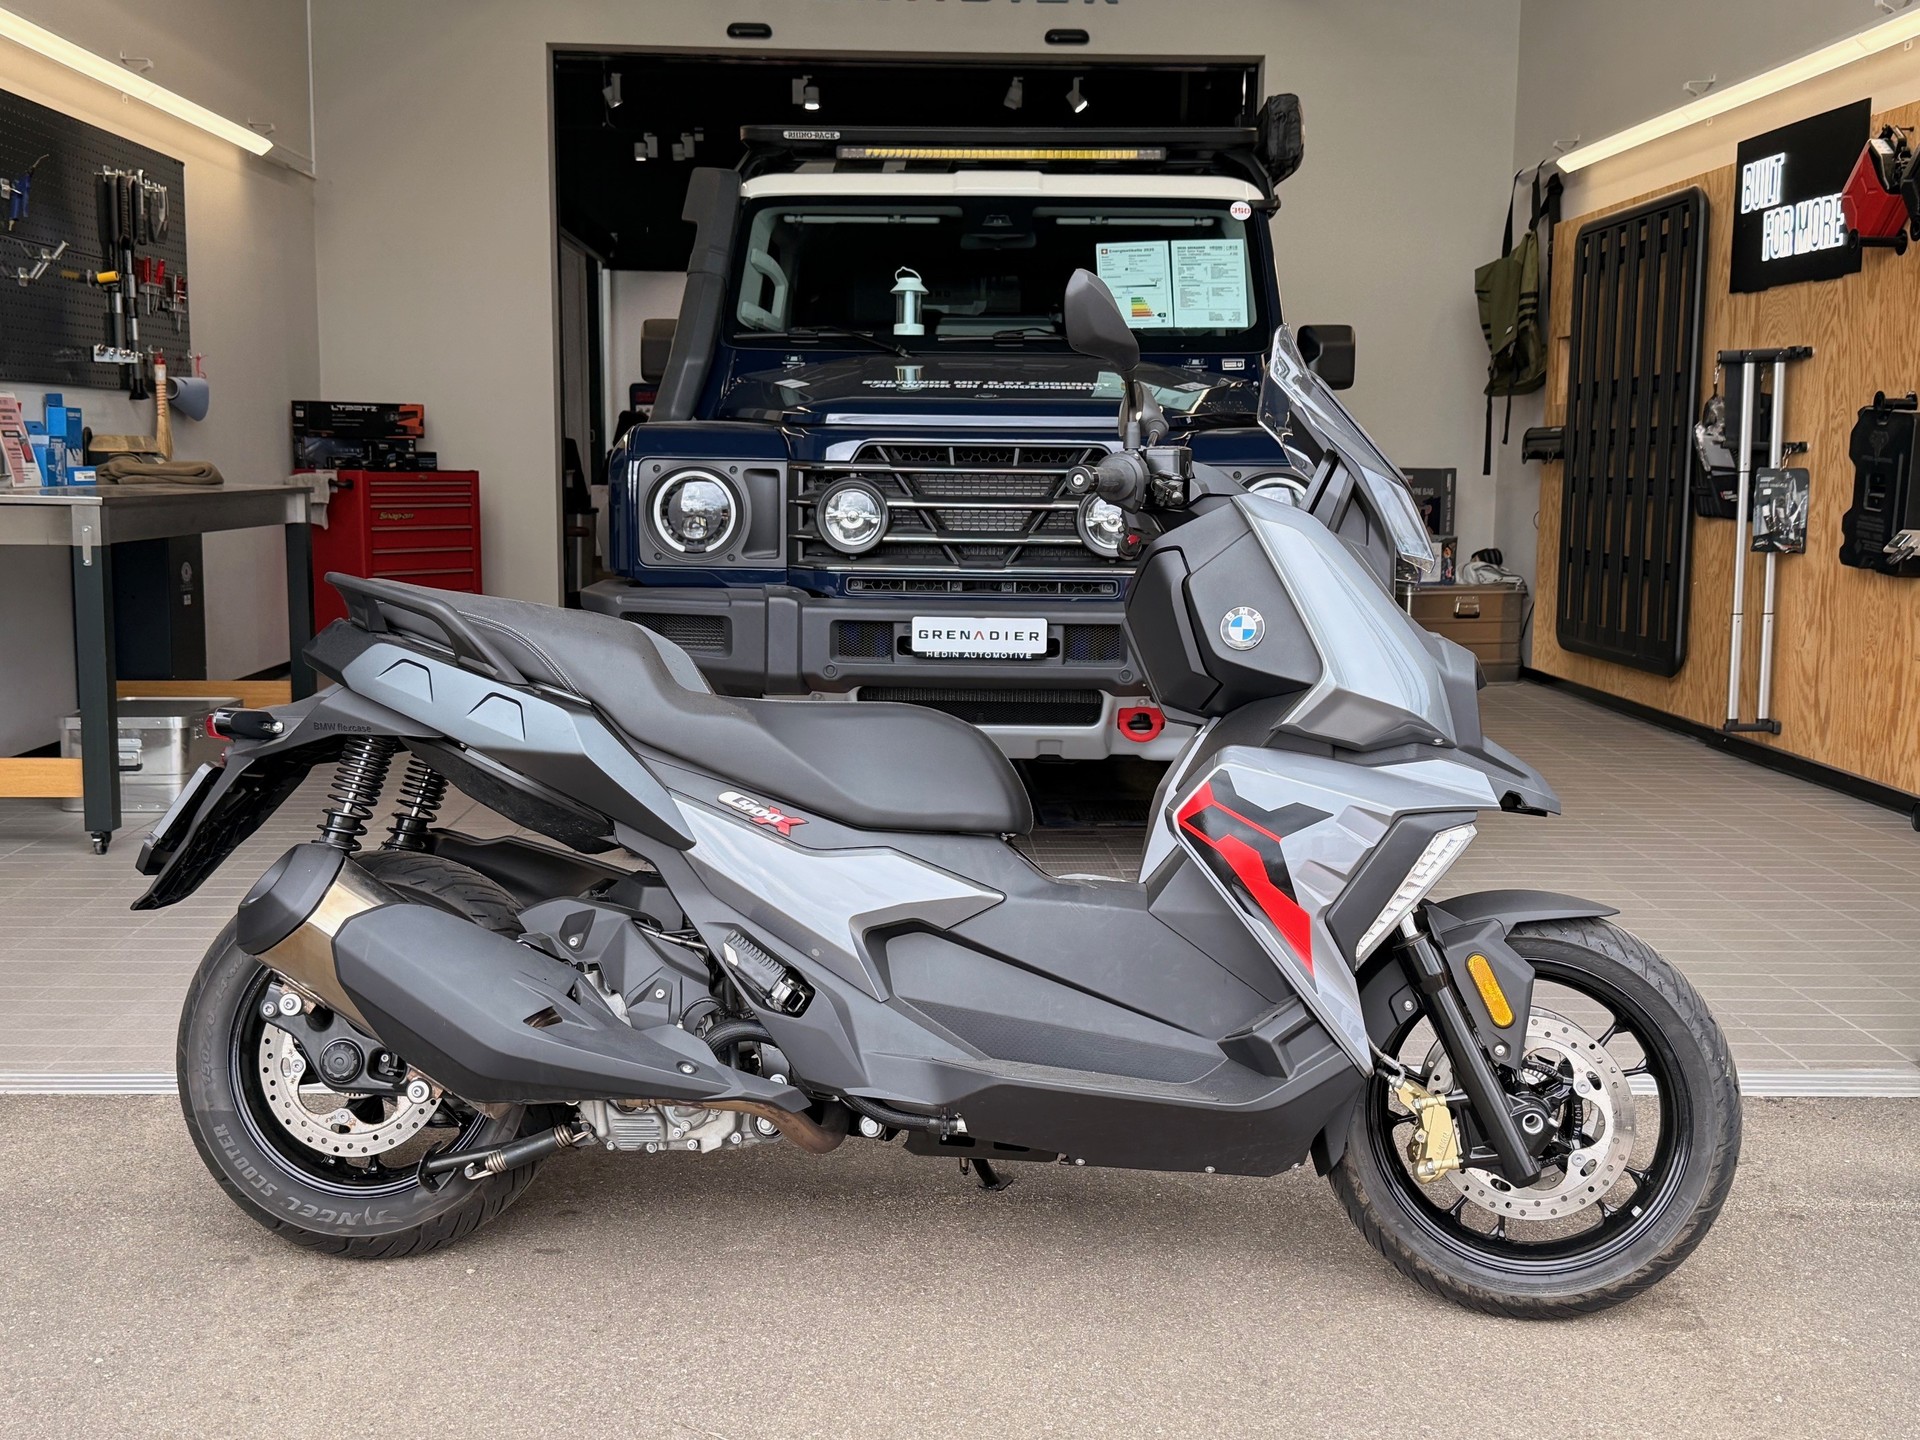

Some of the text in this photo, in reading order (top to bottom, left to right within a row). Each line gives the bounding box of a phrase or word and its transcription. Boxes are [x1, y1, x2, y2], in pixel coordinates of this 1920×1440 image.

[1741, 153, 1785, 214] BUILT
[1761, 193, 1845, 262] FOR MORE
[1225, 607, 1262, 622] BMW
[918, 629, 1040, 641] GRENADIER
[313, 721, 371, 733] BMW flexcase
[212, 1123, 279, 1198] SCOOTER
